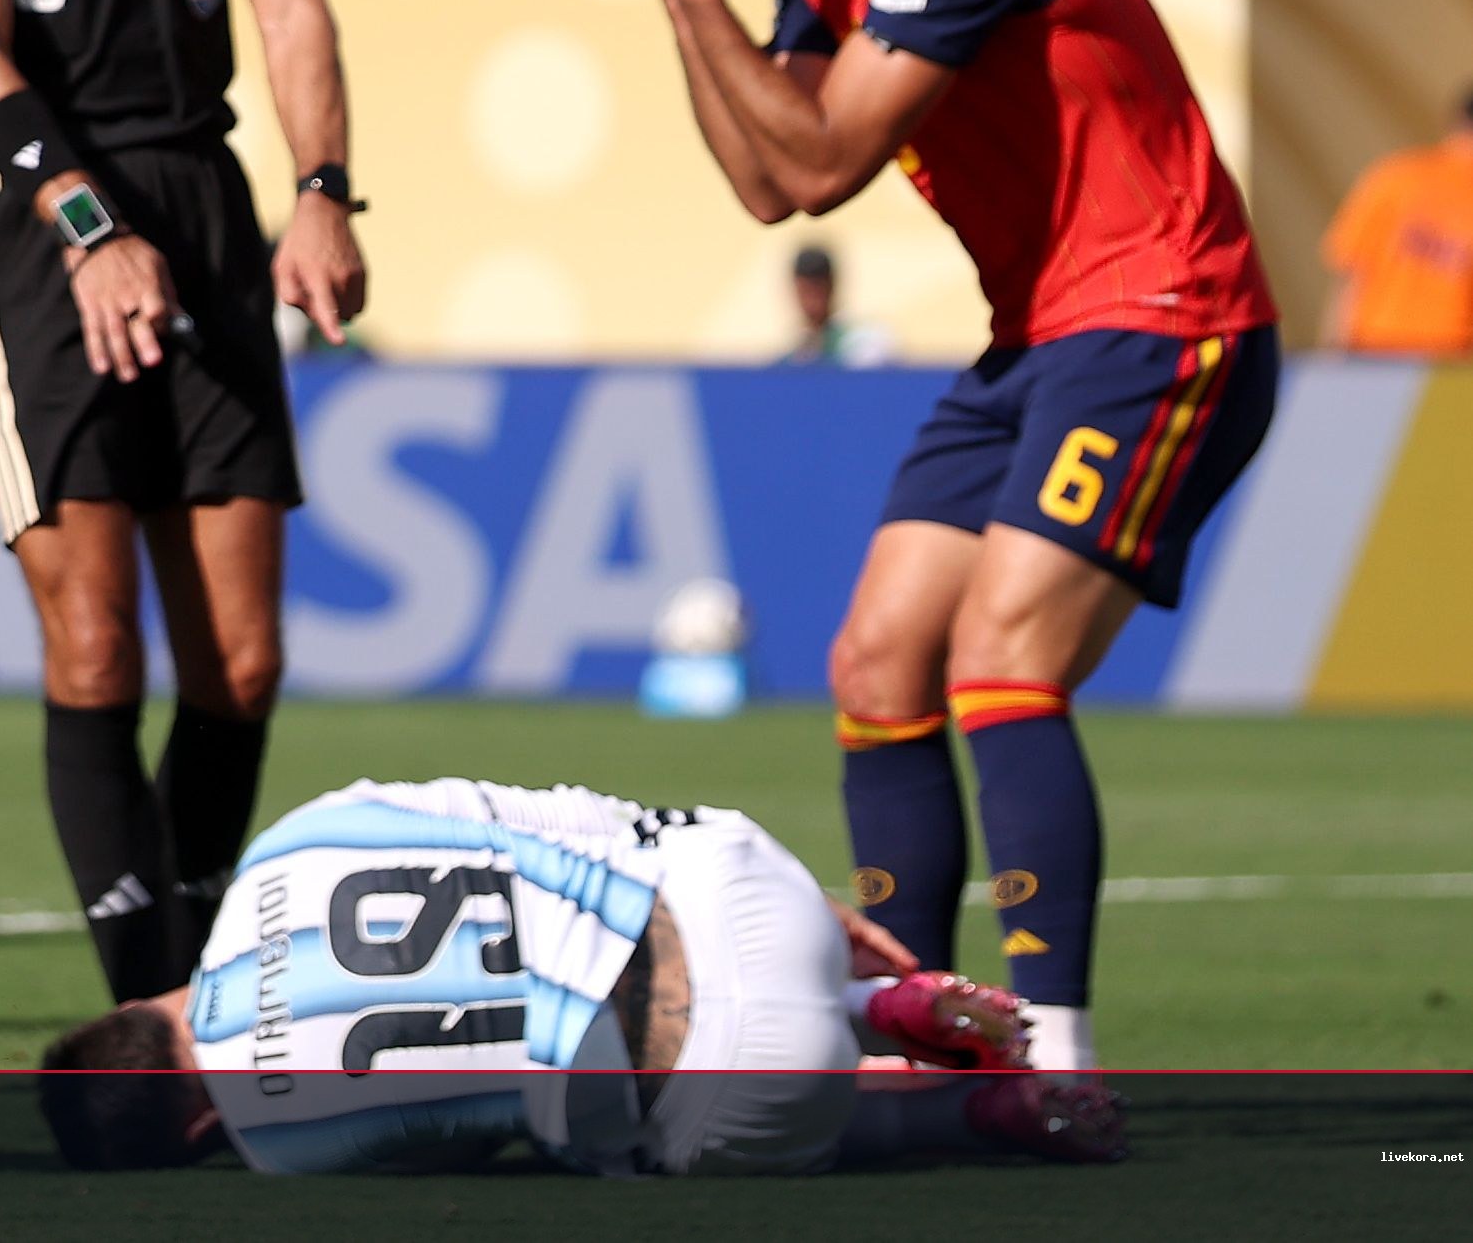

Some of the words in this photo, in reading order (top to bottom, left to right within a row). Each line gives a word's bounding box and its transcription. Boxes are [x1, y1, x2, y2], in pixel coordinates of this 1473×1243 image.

[1038, 426, 1119, 525] 6
[254, 874, 295, 1096] OTAMENDI
[328, 862, 526, 1078] 19
